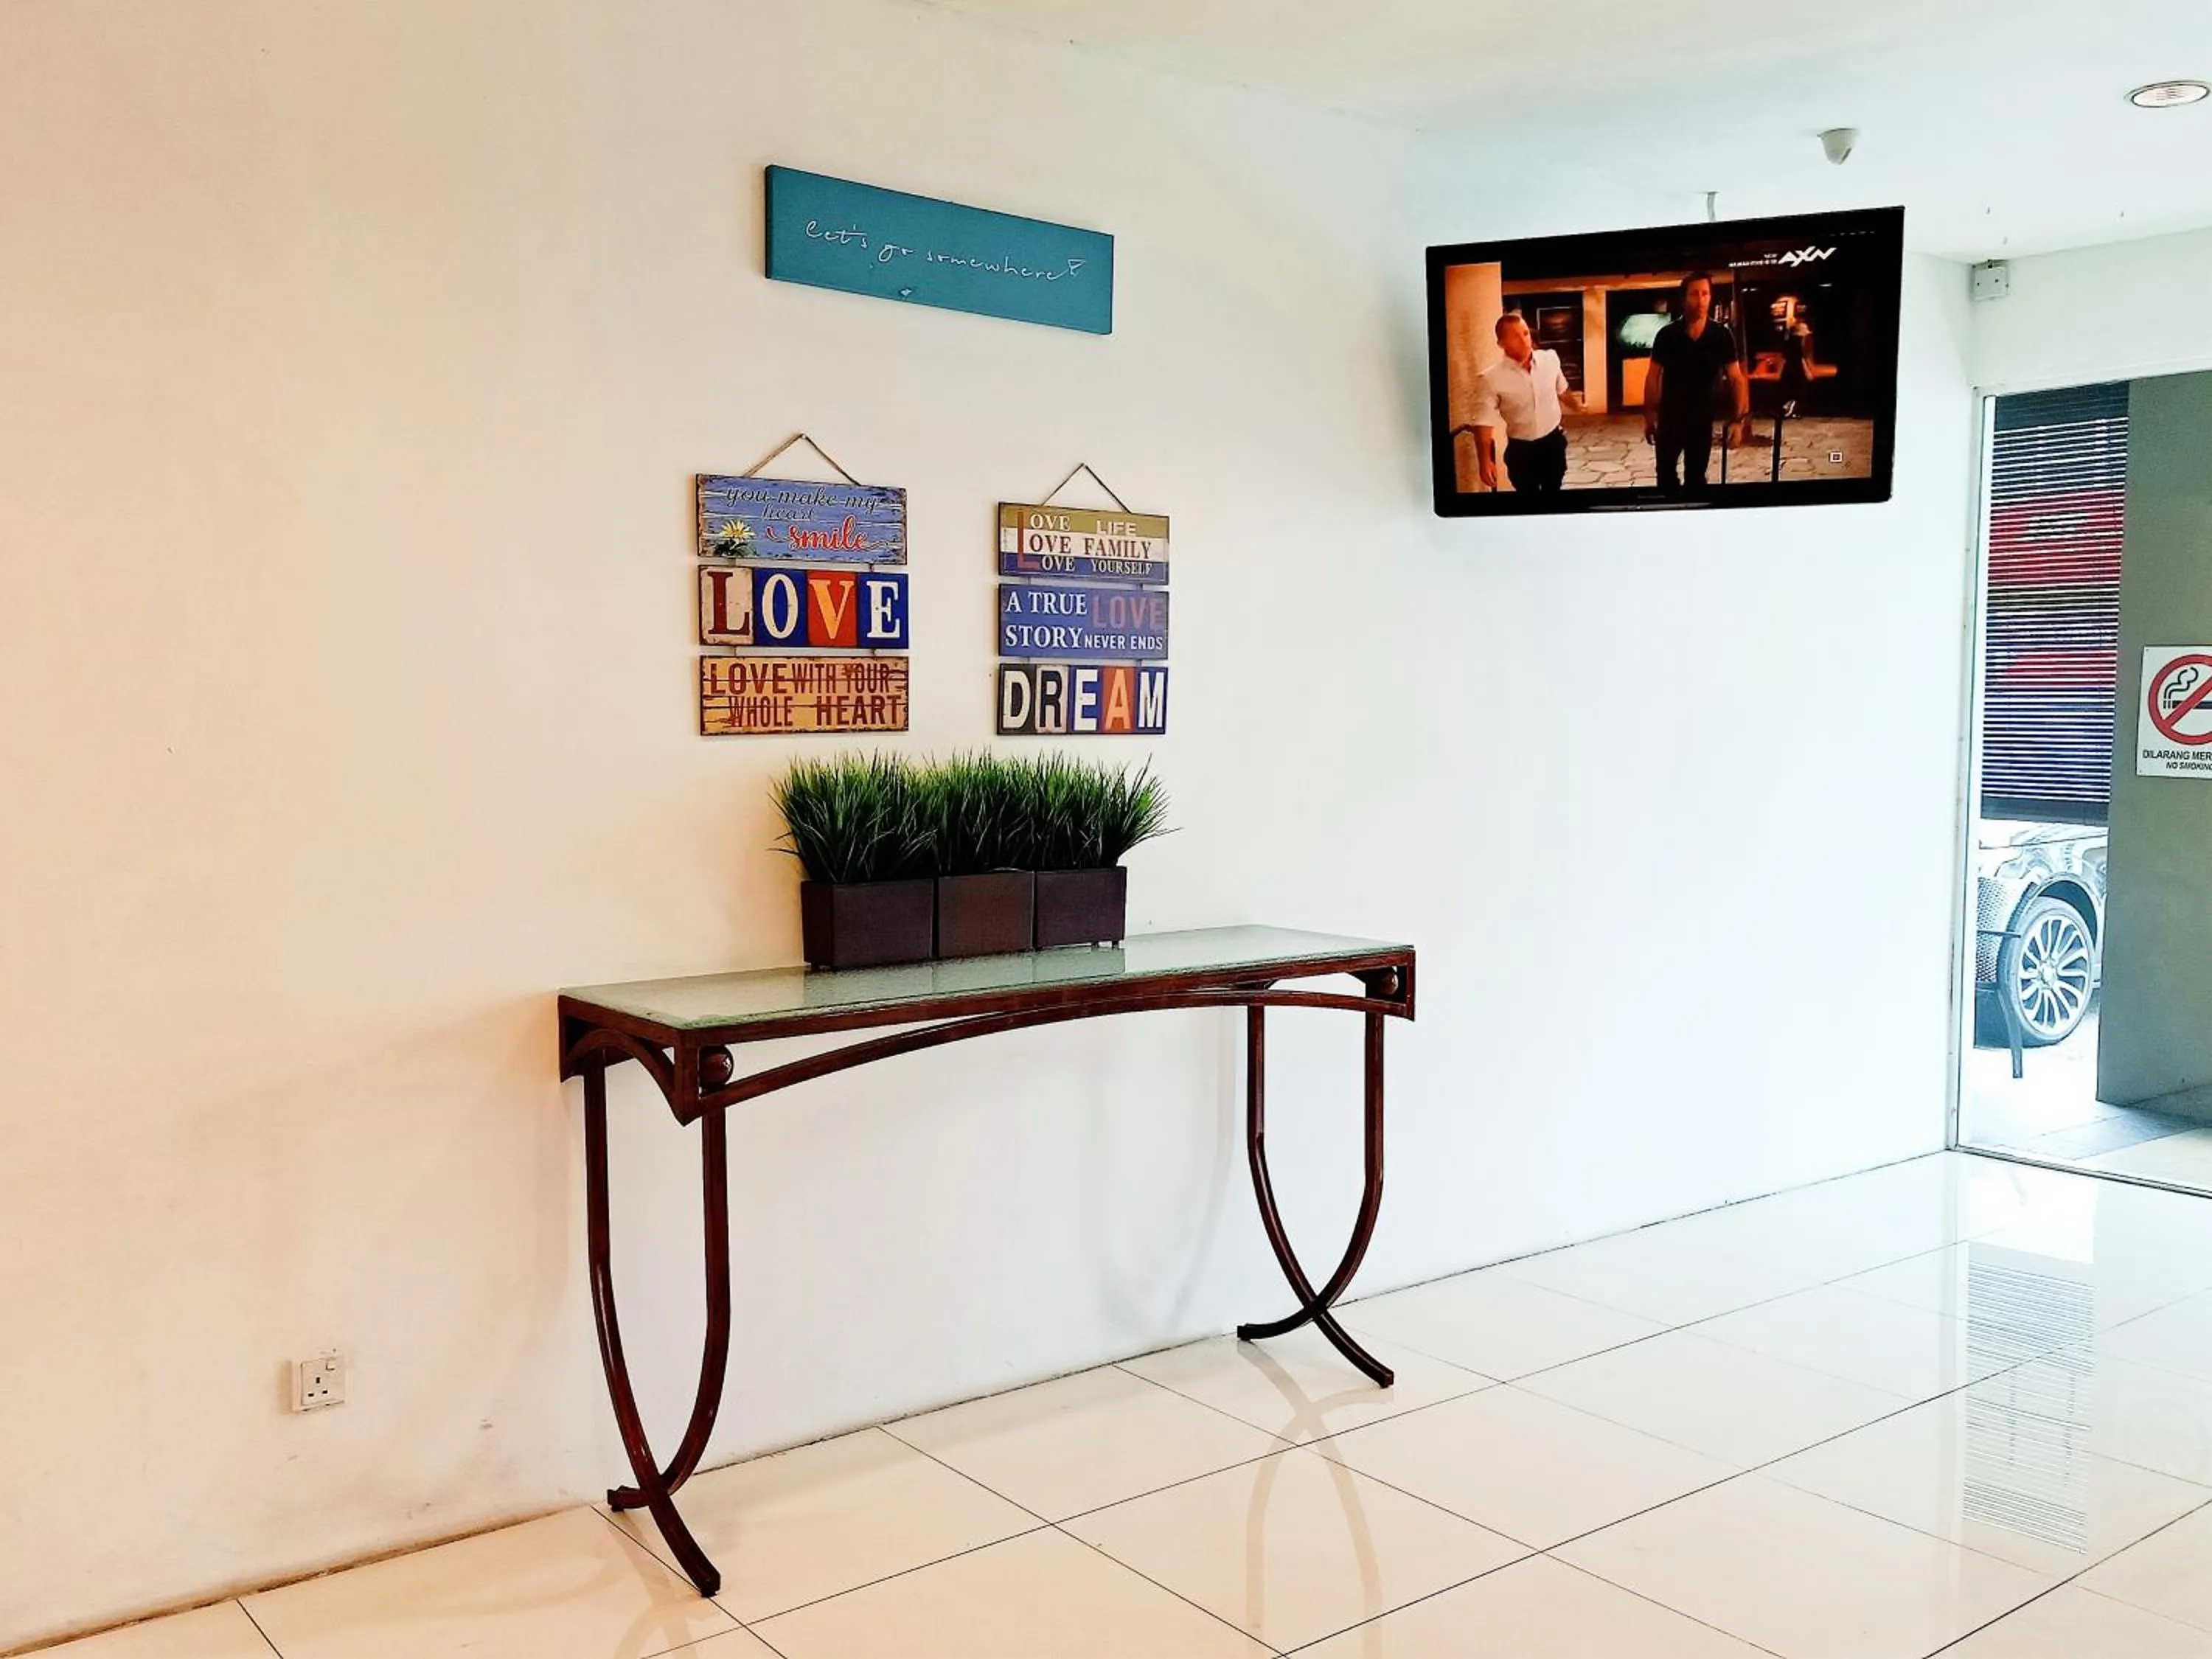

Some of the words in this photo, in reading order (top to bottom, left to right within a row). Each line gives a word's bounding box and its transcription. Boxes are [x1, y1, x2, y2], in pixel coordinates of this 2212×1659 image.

[878, 244, 914, 262] go
[1778, 246, 1837, 268] AXN
[726, 487, 767, 507] you
[777, 487, 838, 507] make
[846, 495, 881, 514] my
[761, 503, 814, 520] heart
[787, 515, 869, 551] smile
[1096, 520, 1138, 537] LIFE
[1085, 538, 1152, 560] FAMILY
[1091, 559, 1152, 575] YOURSELF
[707, 571, 900, 640] LOVE
[1005, 591, 1022, 613] A
[1028, 592, 1088, 615] TRUE
[1093, 596, 1163, 630] LOVE
[1005, 625, 1083, 649] STORY
[1085, 634, 1126, 650] NEVER
[1130, 636, 1163, 650] ENDS
[710, 664, 788, 694] LOVE
[791, 663, 835, 694] WITH
[844, 663, 891, 693] YOUR
[728, 696, 793, 728] WHOLE
[816, 695, 901, 726] HEART
[1002, 669, 1165, 731] DREAM
[2143, 749, 2190, 760] DILARANG
